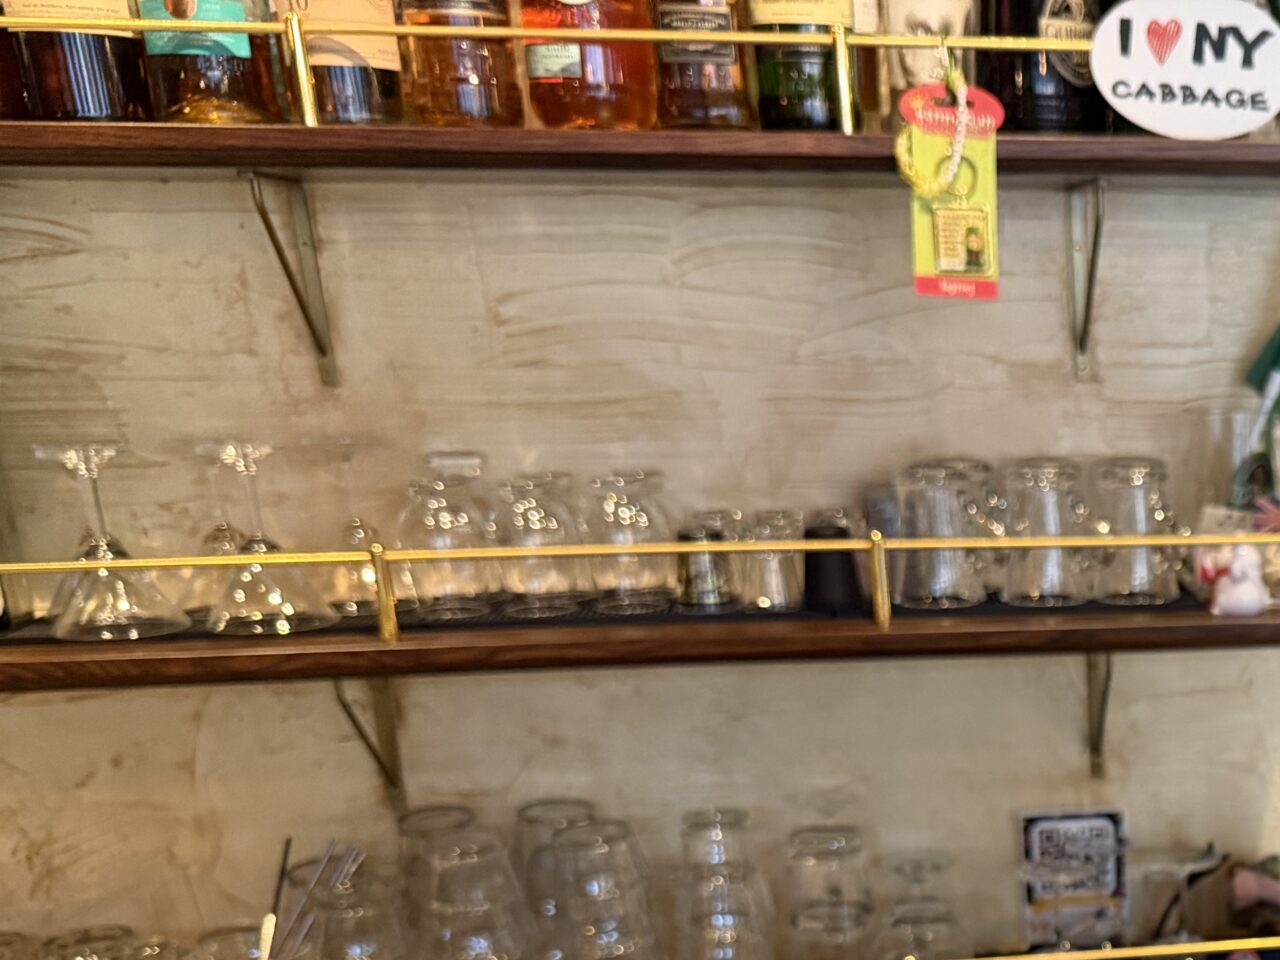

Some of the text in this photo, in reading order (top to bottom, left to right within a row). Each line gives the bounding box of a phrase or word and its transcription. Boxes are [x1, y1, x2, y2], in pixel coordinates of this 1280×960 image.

[1119, 18, 1275, 69] I NY
[1111, 80, 1271, 112] CABBAGE
